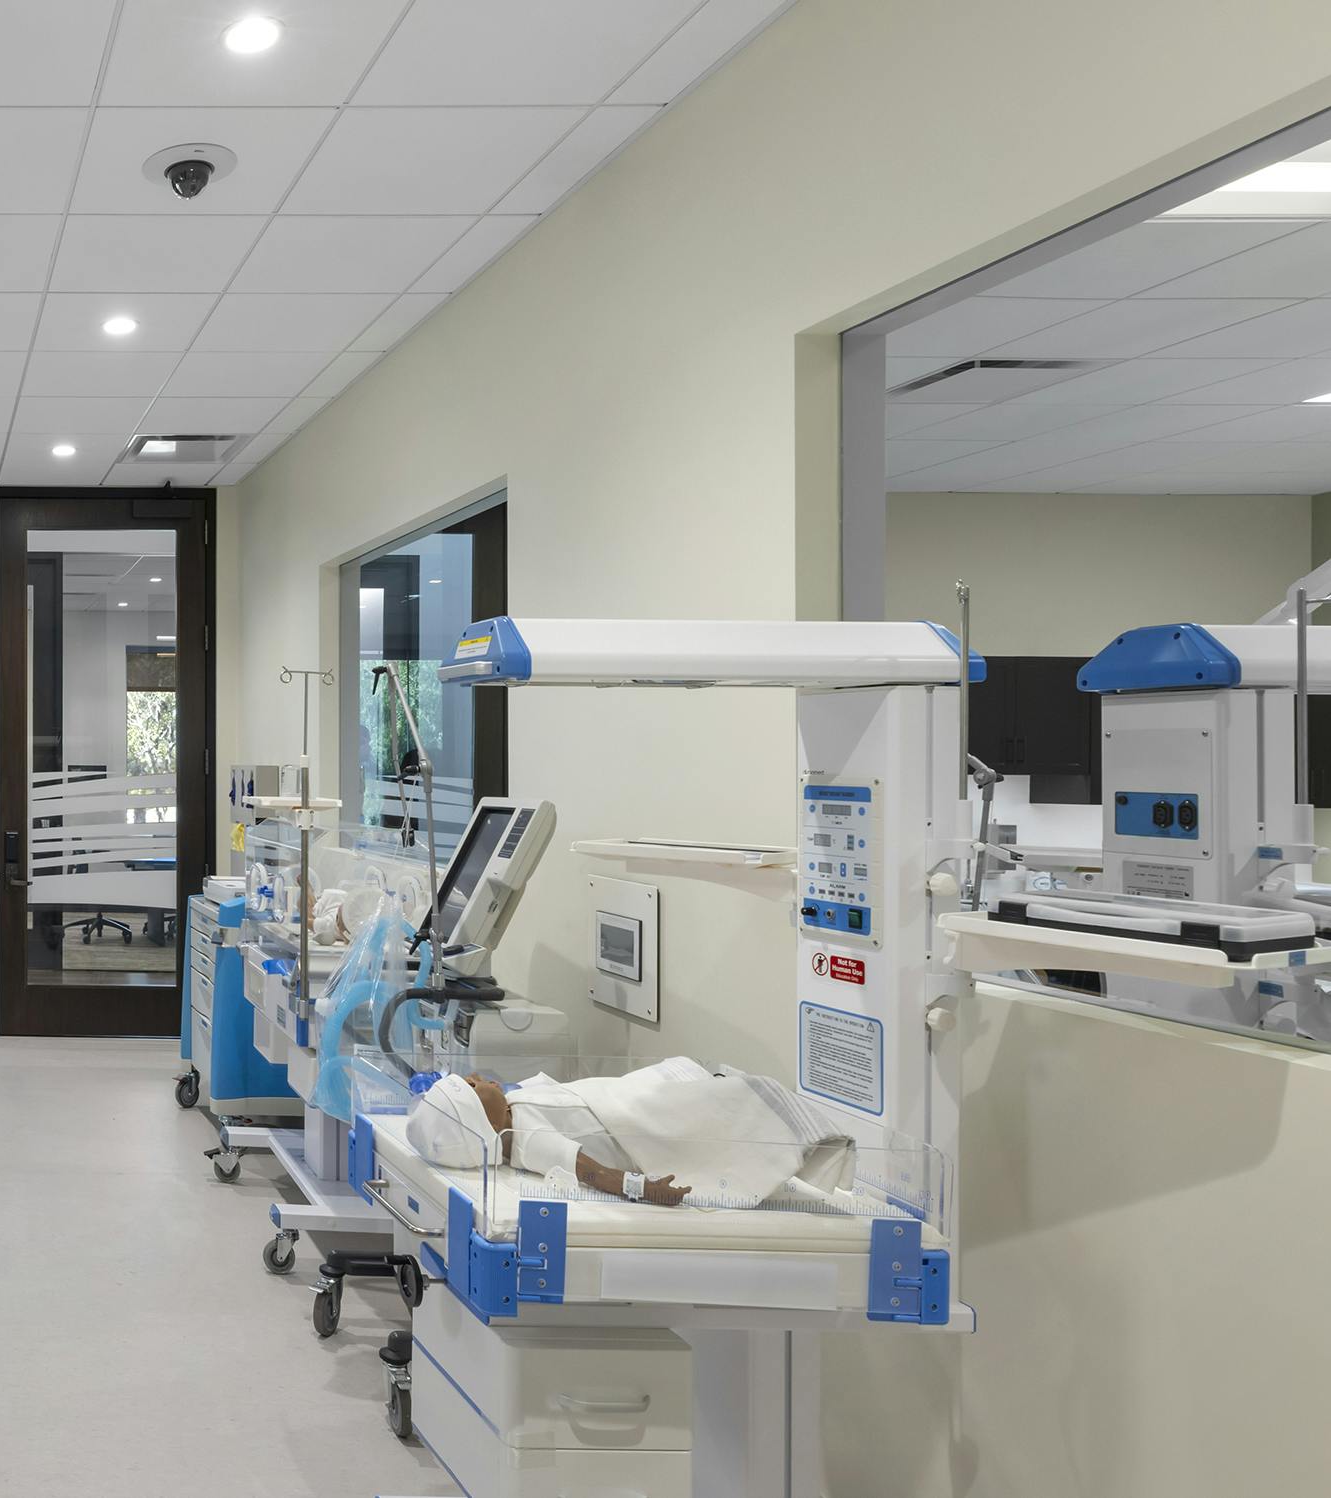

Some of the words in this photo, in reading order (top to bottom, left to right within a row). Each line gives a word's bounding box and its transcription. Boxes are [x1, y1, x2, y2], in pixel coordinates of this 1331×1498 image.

[837, 958, 848, 966] Not
[848, 960, 857, 968] for
[831, 964, 852, 974] Human
[852, 968, 863, 977] Use
